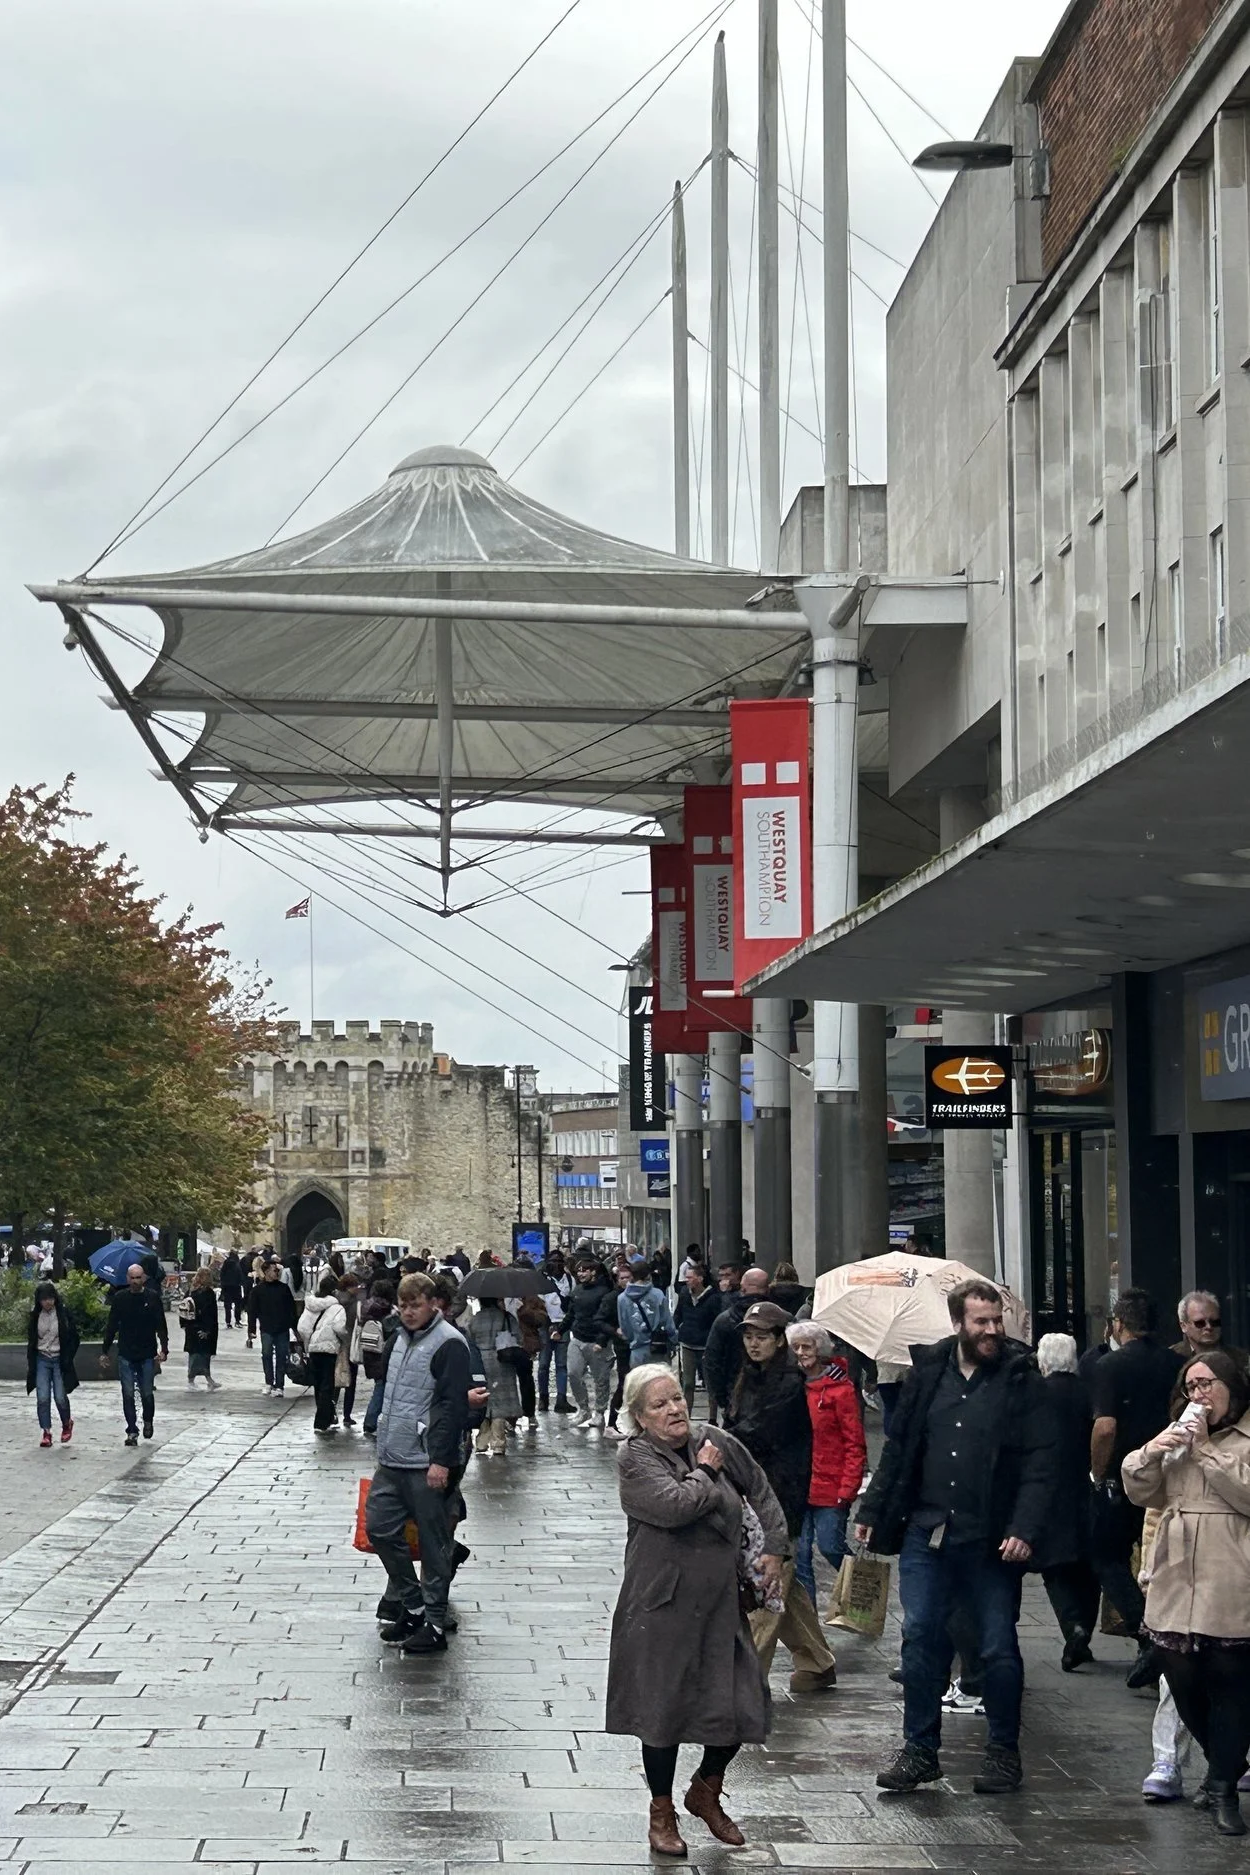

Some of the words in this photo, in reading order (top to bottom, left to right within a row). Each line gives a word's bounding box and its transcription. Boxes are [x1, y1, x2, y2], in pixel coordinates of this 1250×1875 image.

[756, 811, 771, 926] SOUTHAMPTON
[772, 810, 787, 904] WESTQUAY
[704, 876, 717, 971] SOUTHAMPTON
[717, 875, 729, 952] WESTQUAY
[932, 1104, 1006, 1113] TRAILFINDERS
